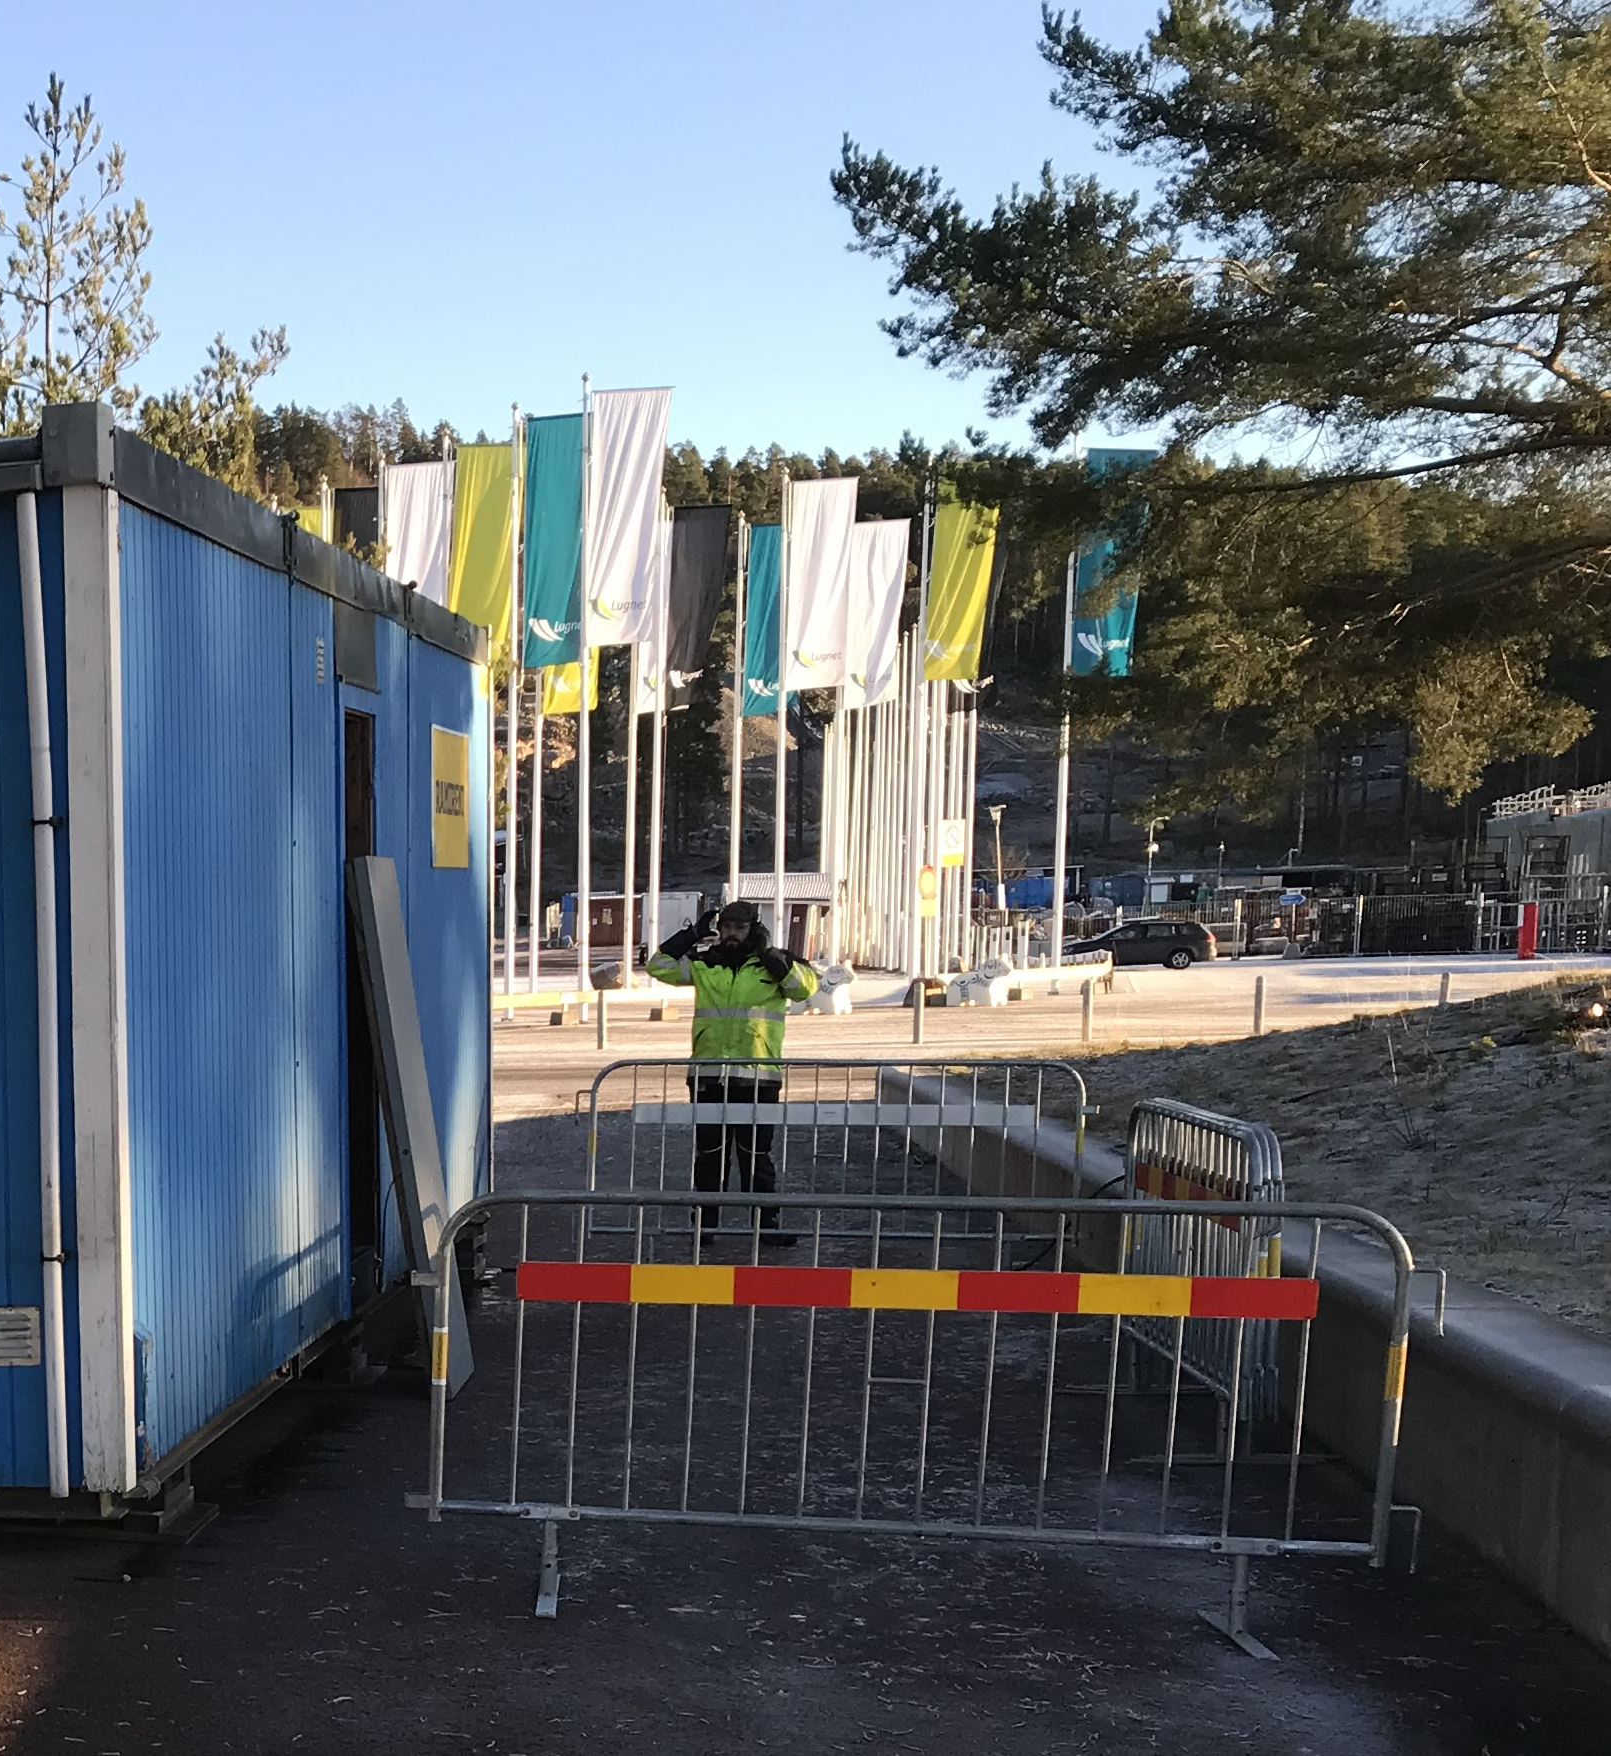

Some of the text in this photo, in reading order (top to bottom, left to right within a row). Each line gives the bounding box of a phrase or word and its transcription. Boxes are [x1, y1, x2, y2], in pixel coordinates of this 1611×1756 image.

[610, 599, 645, 612] Lugne
[554, 620, 581, 635] Lugne
[810, 650, 843, 664] Lugnet
